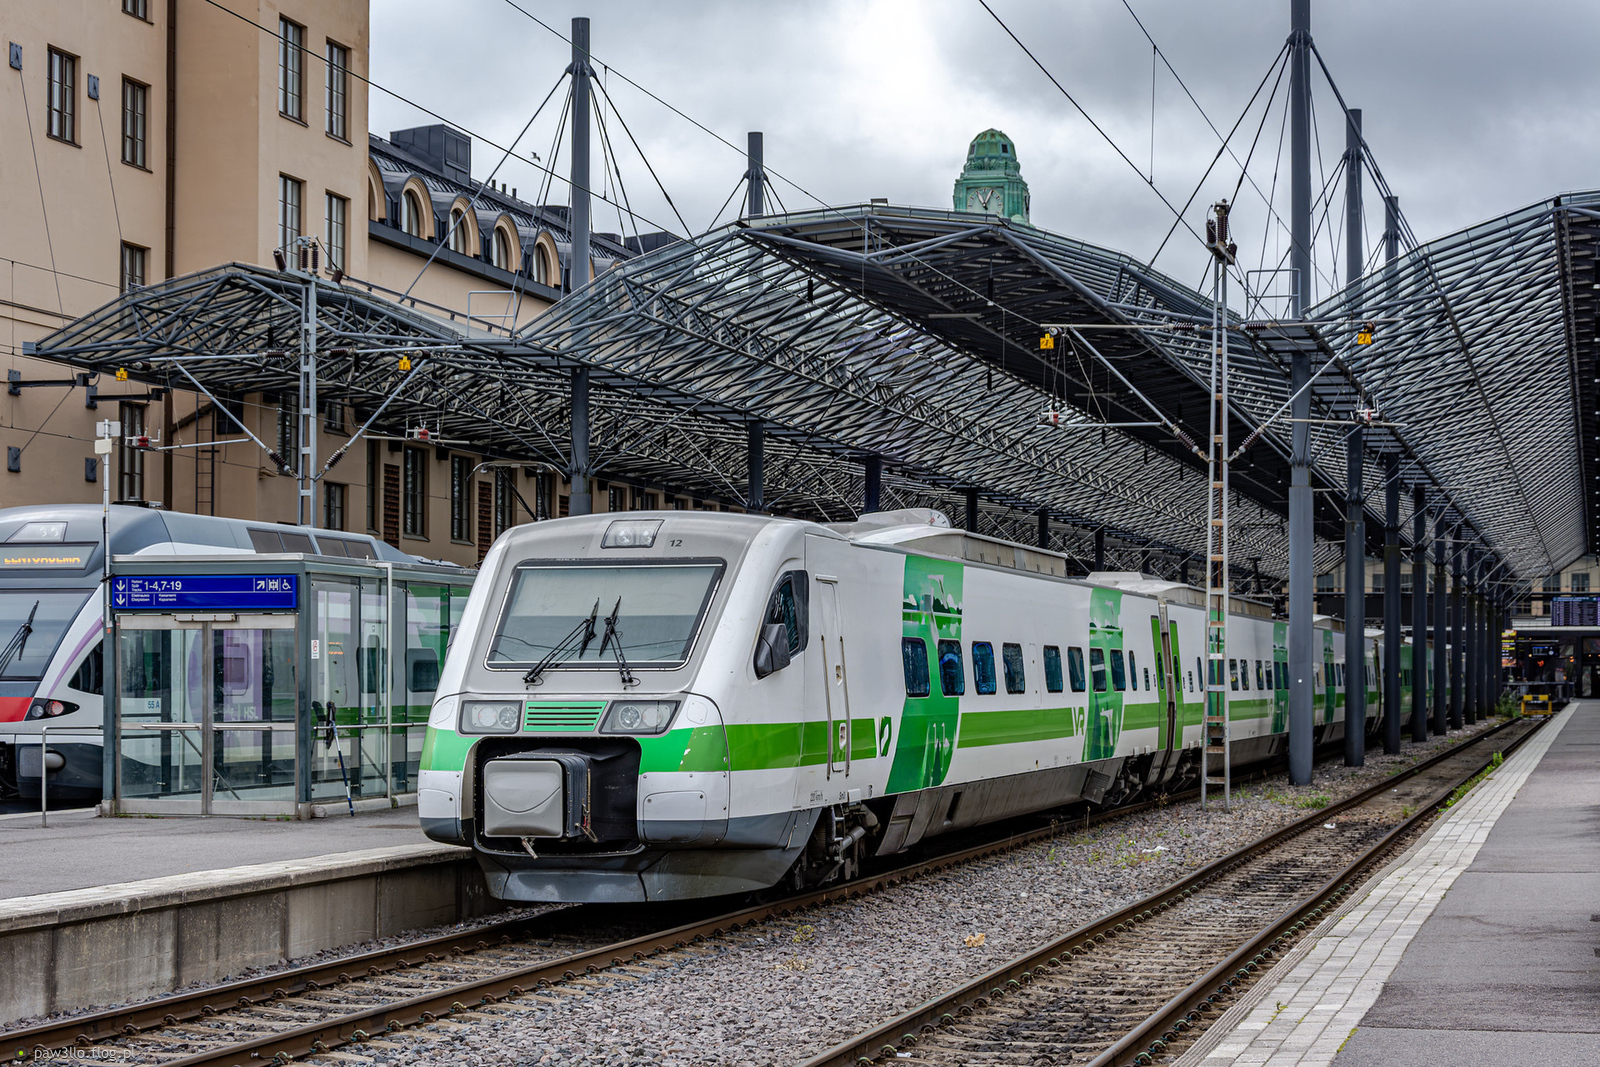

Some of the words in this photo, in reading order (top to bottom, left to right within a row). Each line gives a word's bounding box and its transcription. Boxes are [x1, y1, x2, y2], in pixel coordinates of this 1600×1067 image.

[1358, 333, 1371, 344] 2A
[144, 581, 182, 591] 1-4,7-19
[243, 706, 259, 719] HSL
